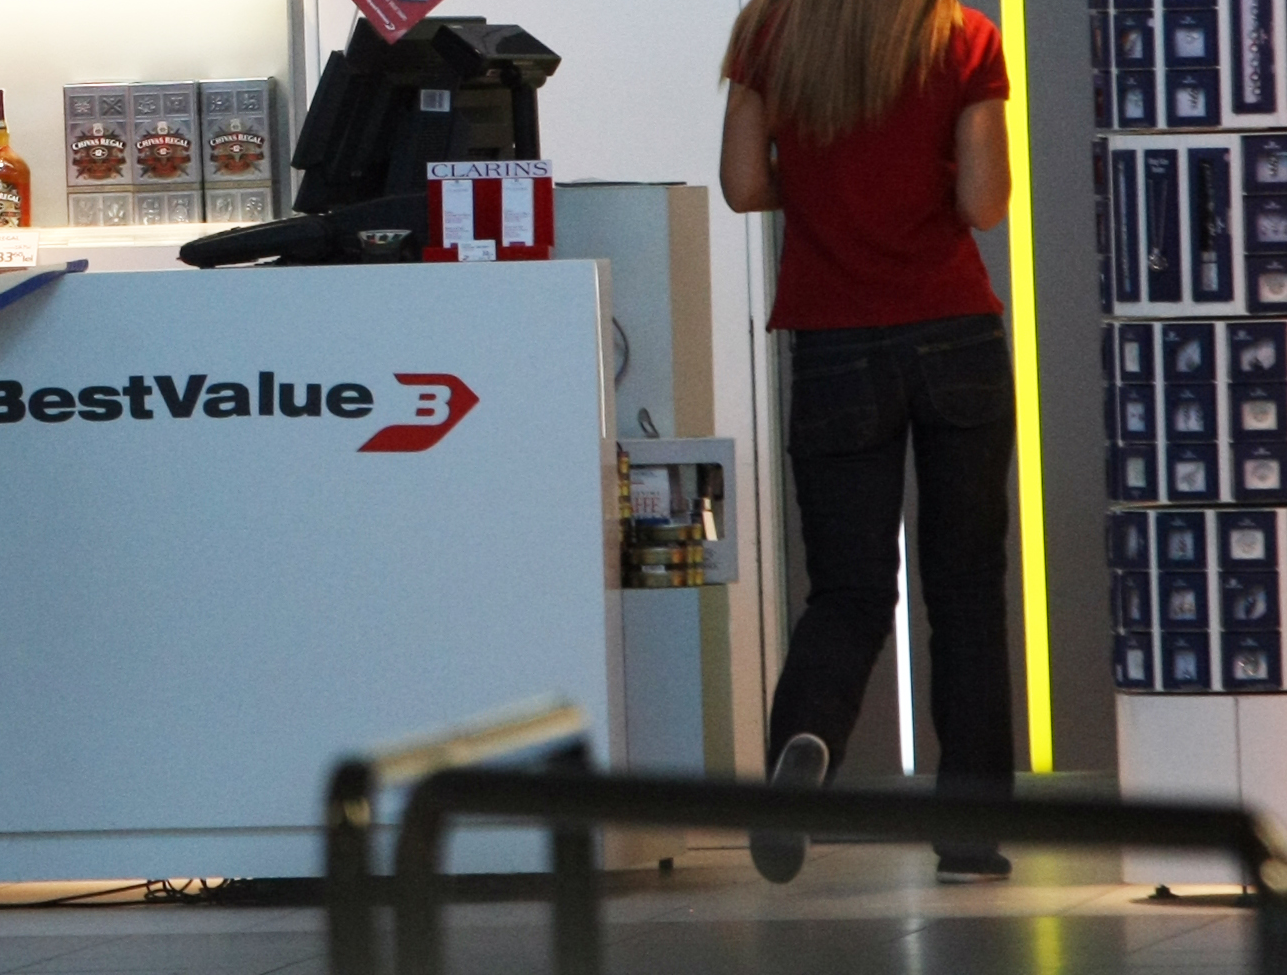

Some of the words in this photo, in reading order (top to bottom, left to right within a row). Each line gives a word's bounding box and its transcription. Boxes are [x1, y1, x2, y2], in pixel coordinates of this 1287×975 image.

[71, 137, 99, 150] CHIVAS
[100, 137, 124, 149] REGAL
[137, 137, 163, 149] CHIVAS
[164, 136, 188, 148] REGAL
[210, 134, 237, 146] CHIVAS
[238, 133, 263, 144] REGAL
[431, 161, 548, 178] CLARINS
